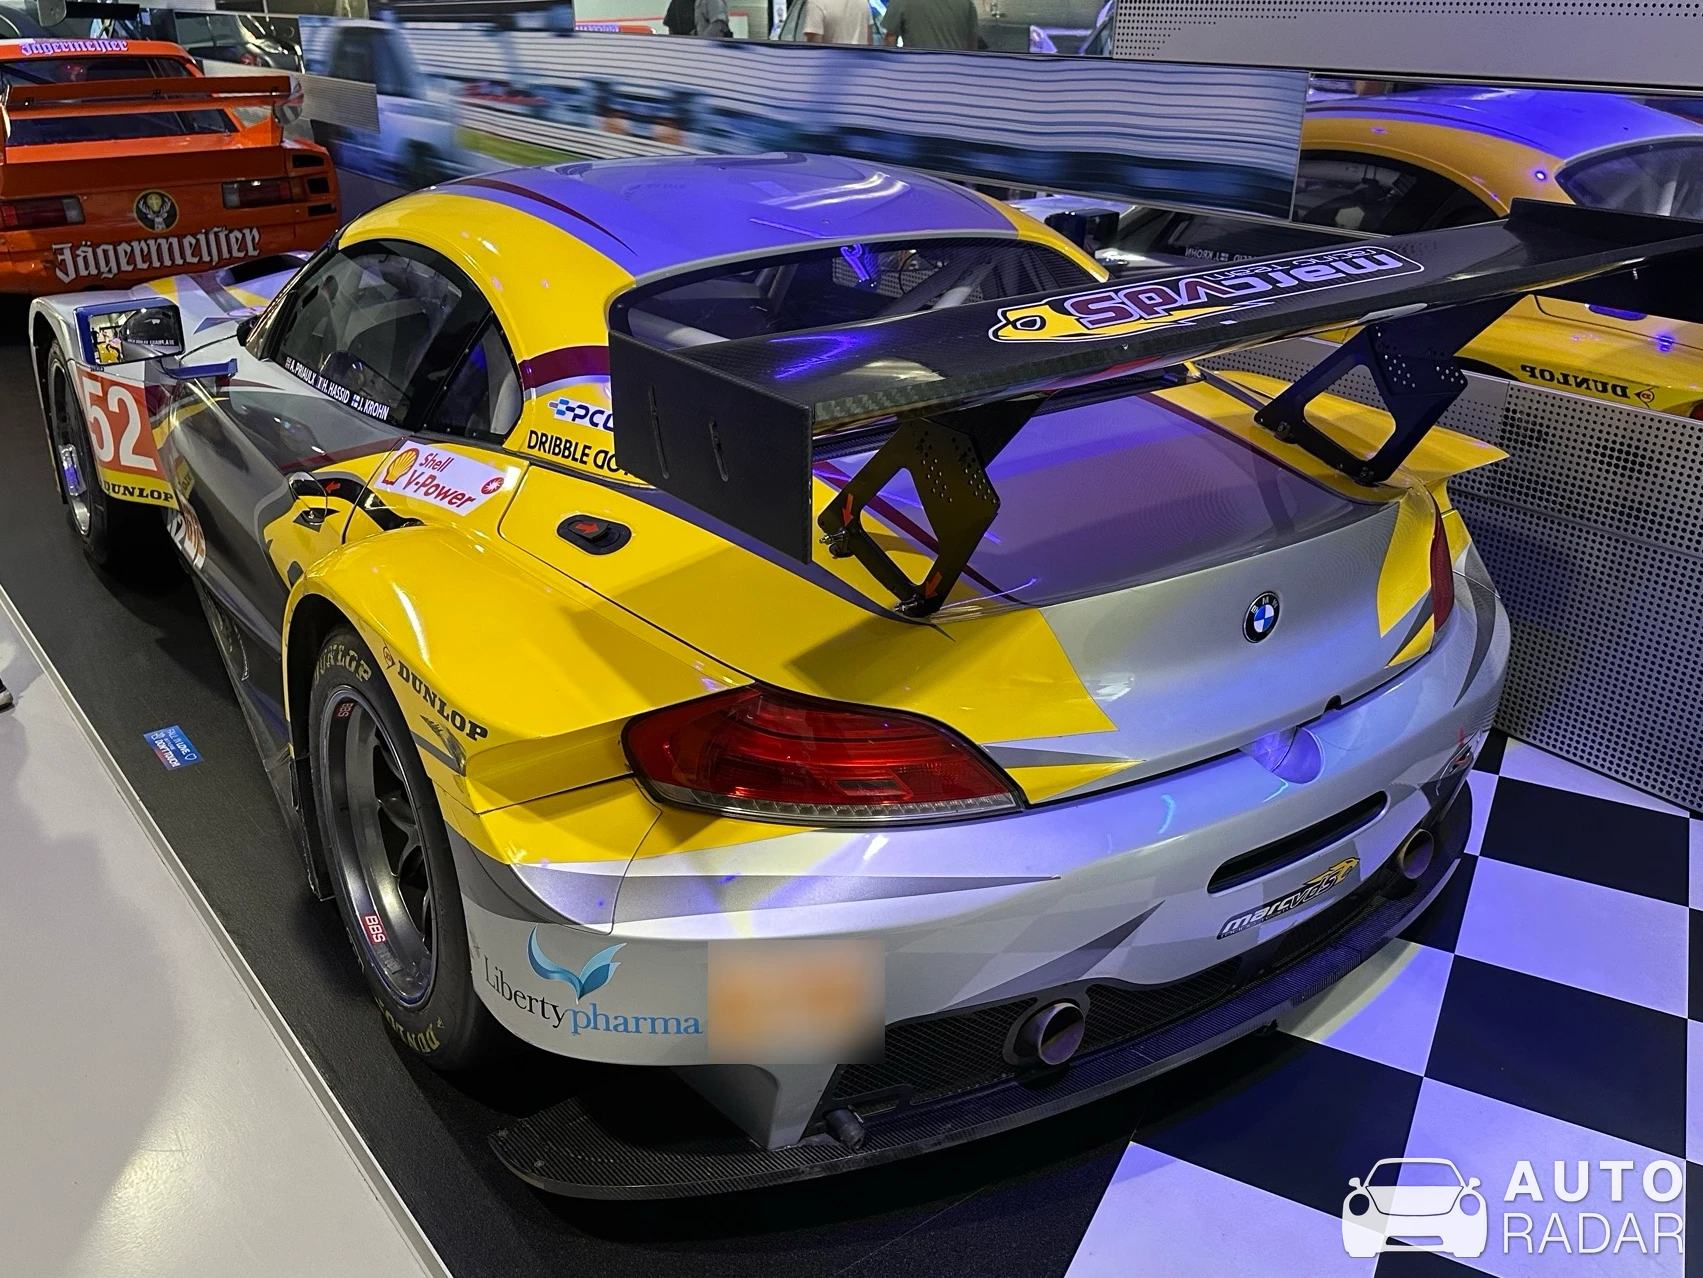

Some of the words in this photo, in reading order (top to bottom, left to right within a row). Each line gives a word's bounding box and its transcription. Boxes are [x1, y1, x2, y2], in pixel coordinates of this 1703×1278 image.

[82, 376, 158, 472] 52
[419, 453, 454, 472] Shell
[527, 429, 592, 465] DRIBBLE
[104, 482, 174, 502] DUNLOP
[403, 470, 476, 508] V-Power
[398, 660, 488, 741] DUNLOP
[365, 915, 386, 943] BBS
